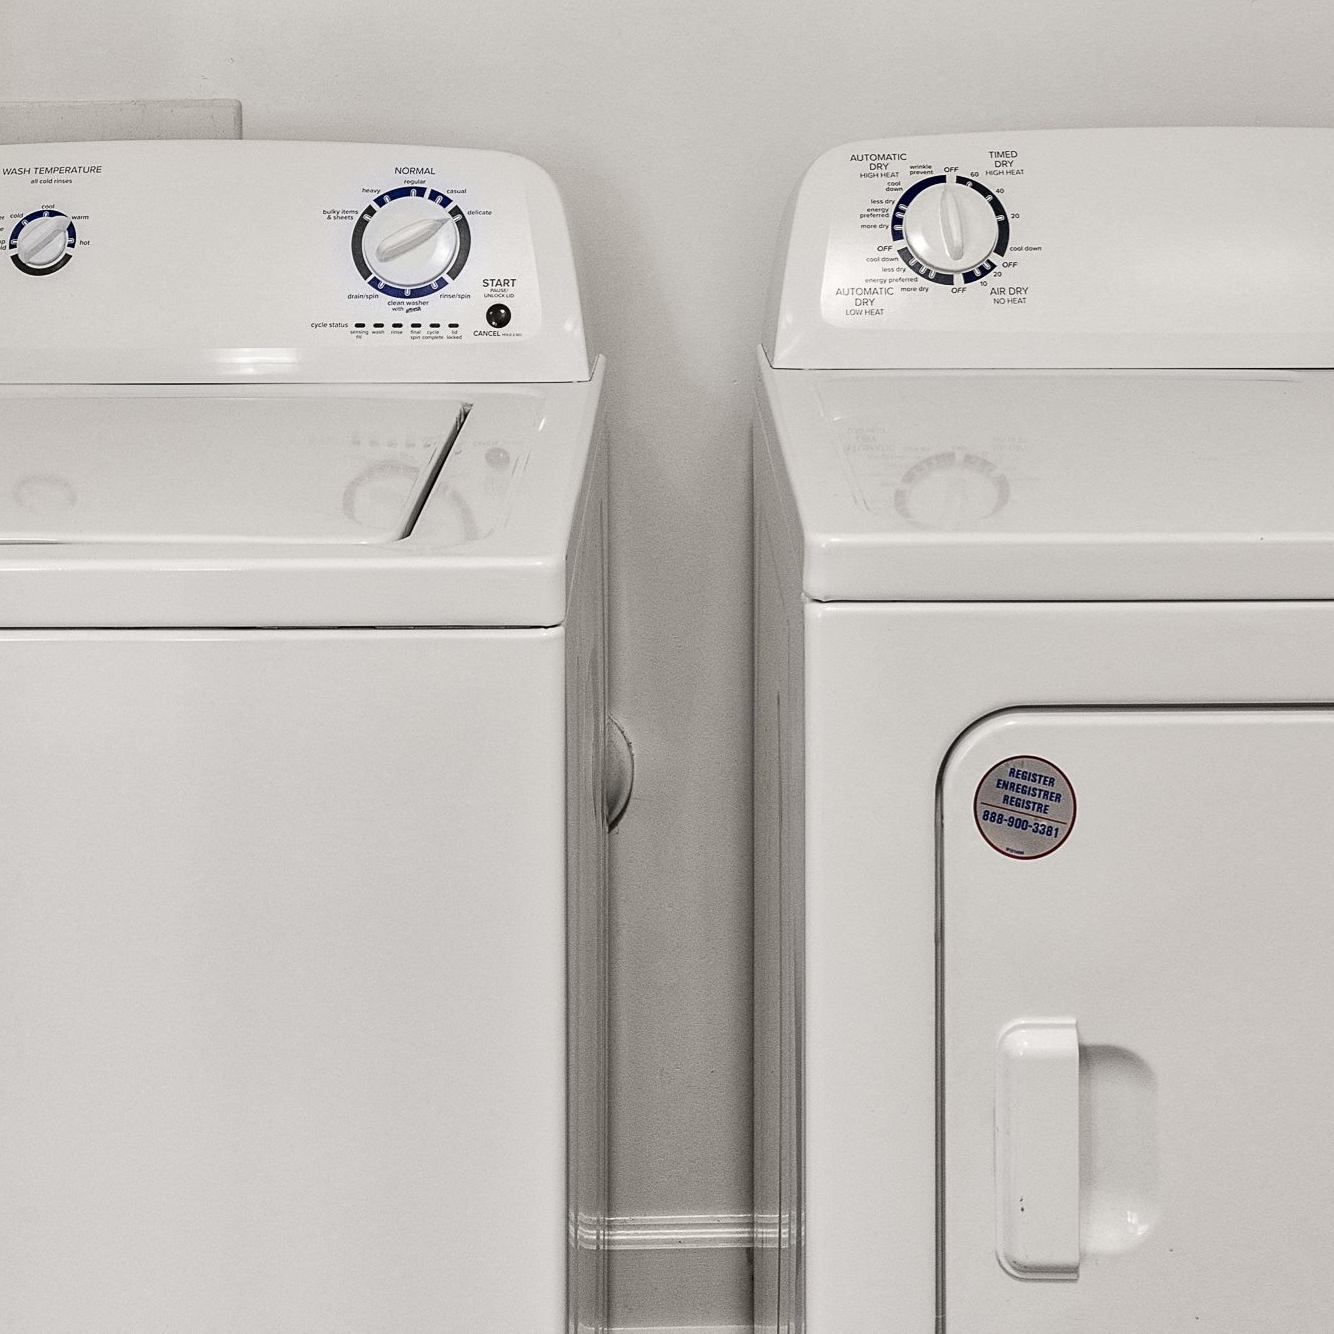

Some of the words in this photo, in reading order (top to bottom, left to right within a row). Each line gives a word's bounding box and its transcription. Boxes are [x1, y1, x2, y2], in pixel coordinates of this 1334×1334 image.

[850, 153, 907, 161] AUTOMATIC
[989, 150, 1018, 159] TIMED
[869, 163, 889, 171] DRY
[995, 160, 1014, 168] DRY
[2, 167, 31, 175] WASH
[33, 165, 102, 175] TEMPERATURE
[394, 167, 436, 175] NORMAL
[482, 278, 517, 287] START
[835, 287, 894, 296] AUTOMATIC
[990, 287, 1006, 296] AIR
[1008, 287, 1029, 296] DRY
[854, 298, 875, 307] DRY
[1009, 767, 1056, 787] REGISTER
[996, 779, 1062, 803] ENREGISTRER
[1002, 794, 1050, 815] REGISTRE
[982, 810, 1059, 838] 888-900-3381
